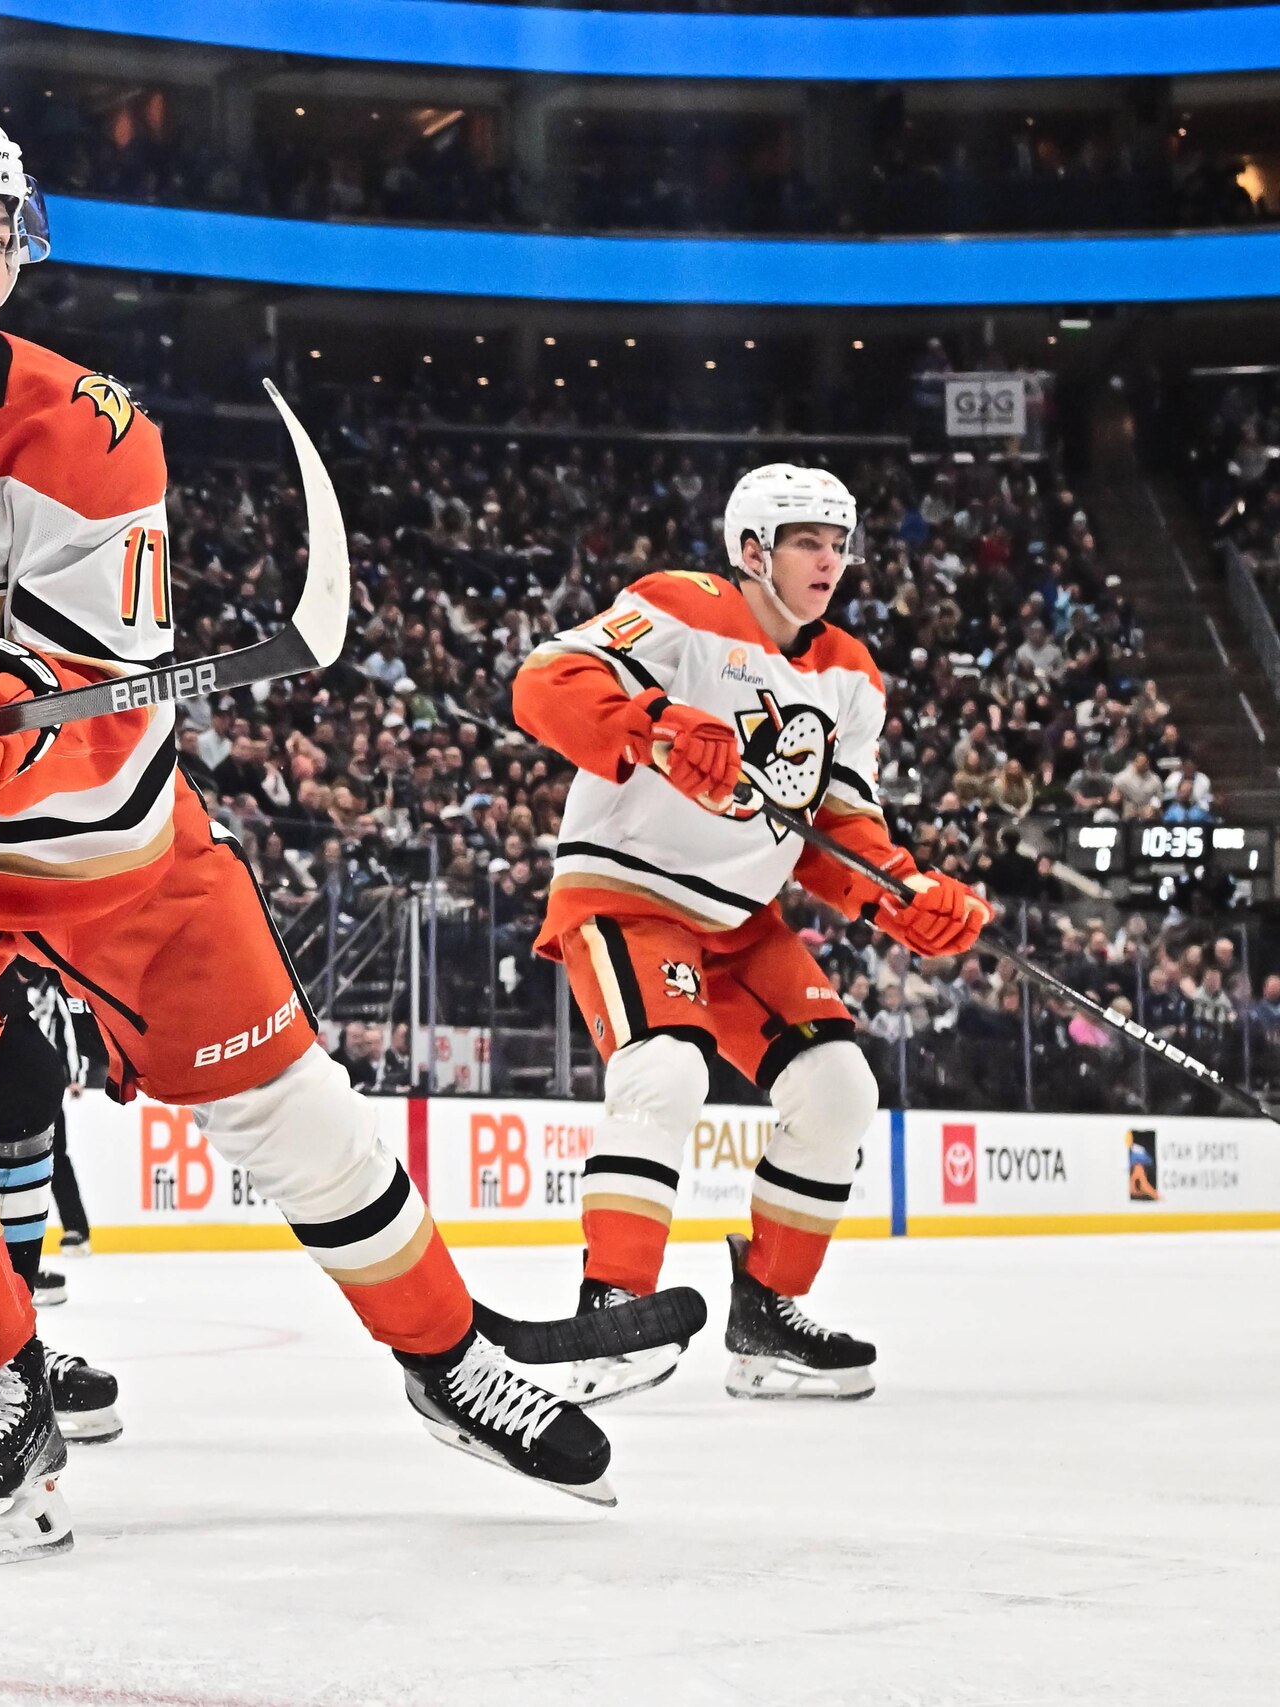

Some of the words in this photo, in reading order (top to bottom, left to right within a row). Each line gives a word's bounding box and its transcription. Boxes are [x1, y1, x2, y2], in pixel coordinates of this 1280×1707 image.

[120, 526, 172, 630] 11
[721, 662, 765, 687] Anaheim
[1141, 826, 1204, 858] 10:35
[141, 1106, 214, 1211] PB
[469, 1114, 532, 1208] PB
[985, 1147, 1067, 1184] TOYOTA
[154, 1168, 177, 1210] fit
[480, 1169, 501, 1208] fit
[546, 1170, 586, 1204] BET
